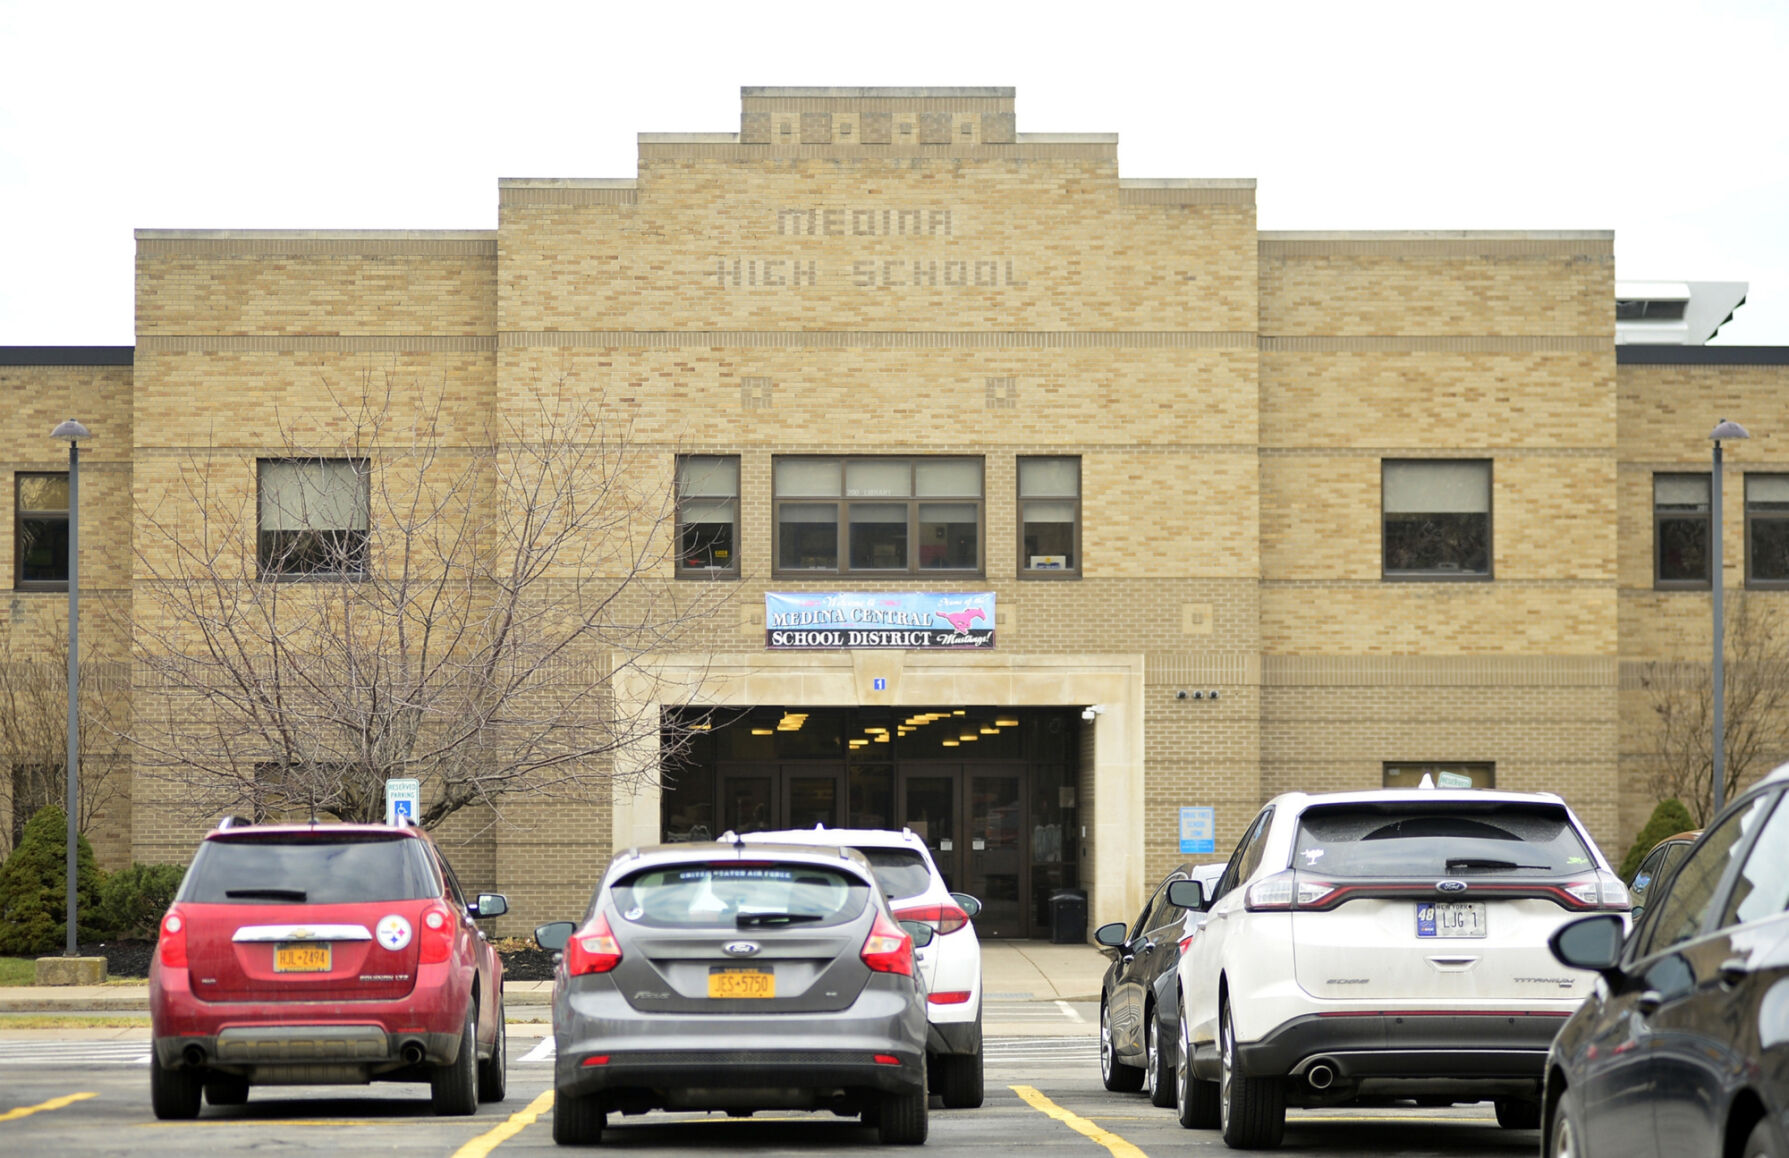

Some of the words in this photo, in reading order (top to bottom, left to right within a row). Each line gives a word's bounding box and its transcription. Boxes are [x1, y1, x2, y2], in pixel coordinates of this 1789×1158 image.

[777, 209, 952, 236] MEDINA
[717, 260, 816, 287] HIGH
[852, 260, 1029, 287] SCHOOL
[772, 606, 848, 628] MEDINA
[849, 606, 934, 628] CENTRAL
[771, 630, 845, 647] SCHOOL
[847, 630, 932, 647] DISTRICT
[936, 631, 992, 648] Mustangs!
[1418, 908, 1435, 921] 48
[1443, 911, 1464, 928] LJG
